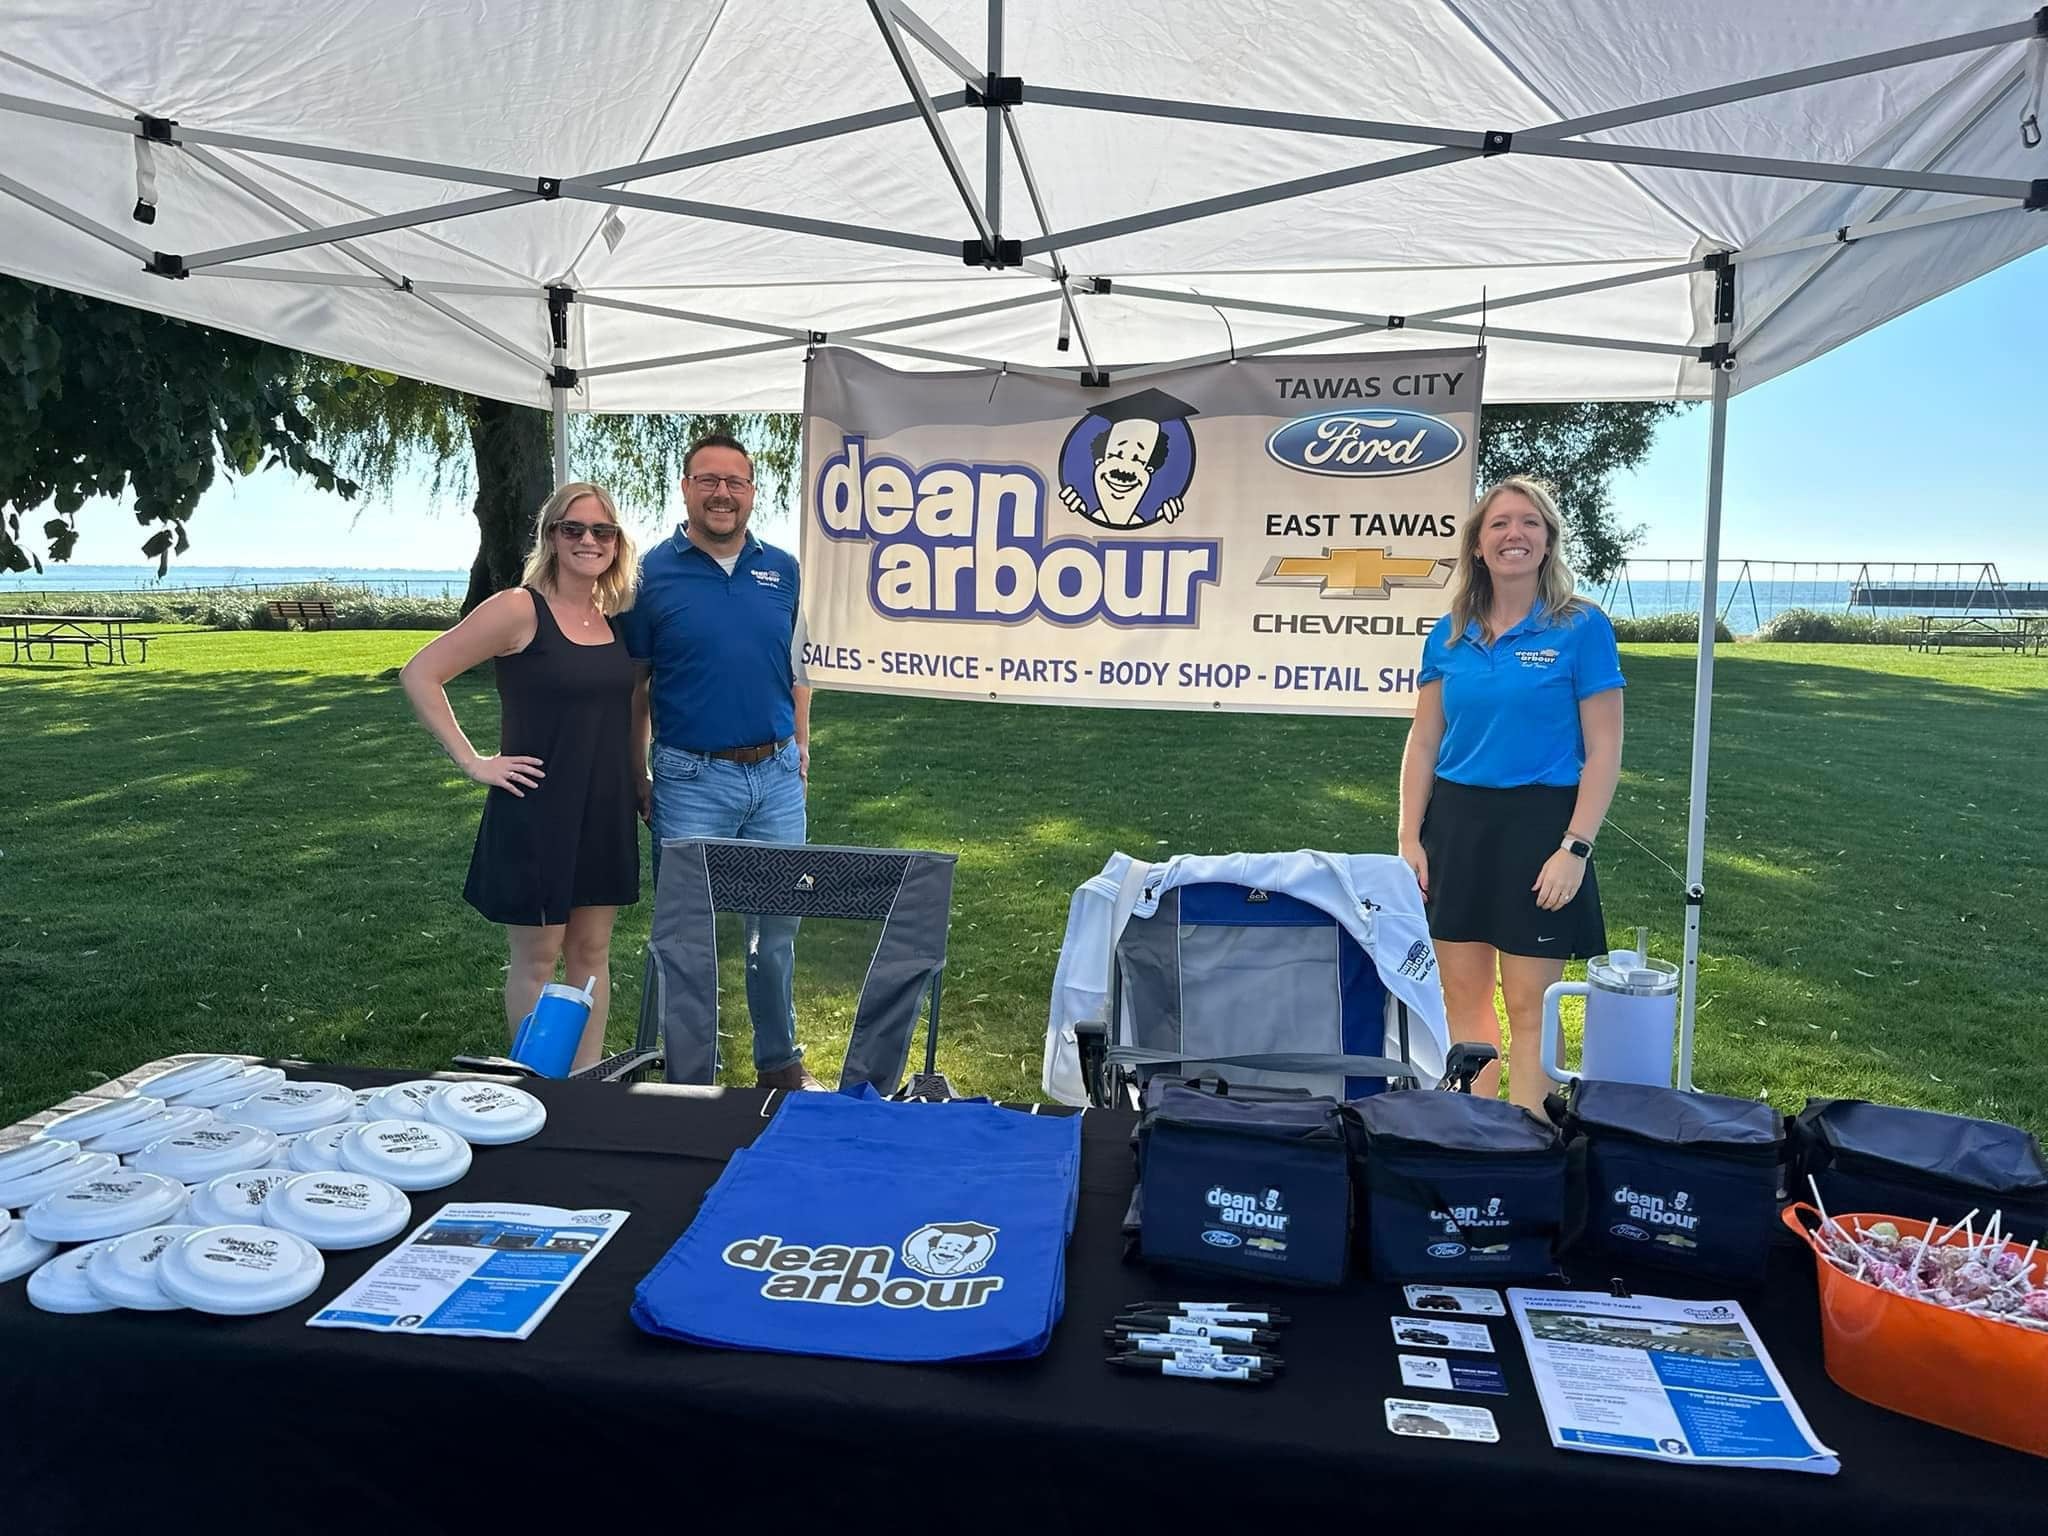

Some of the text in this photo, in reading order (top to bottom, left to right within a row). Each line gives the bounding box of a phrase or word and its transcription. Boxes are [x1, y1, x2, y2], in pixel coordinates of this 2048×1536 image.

[1275, 372, 1464, 399] TAWAS CITY
[1304, 416, 1428, 465] Ford
[820, 442, 1039, 538] dean
[1265, 513, 1456, 537] EAST TAWAS
[875, 541, 1211, 618] arbour
[1253, 614, 1441, 636] CHEVROLE
[801, 641, 862, 671] SALES
[881, 651, 979, 681] SERVICE
[1000, 658, 1077, 685] PARTS
[1100, 661, 1169, 688] BODY
[1178, 663, 1250, 690] SHOP
[1274, 665, 1368, 693] DETAIL
[1378, 667, 1415, 693] SH
[1520, 656, 1556, 664] arbour
[1207, 1187, 1256, 1210] dean
[1614, 1187, 1664, 1210] dean
[1222, 1207, 1288, 1230] arbour
[1630, 1205, 1698, 1229] arbour
[724, 1236, 891, 1274] dean
[1434, 1244, 1459, 1256] Ford
[763, 1274, 1000, 1308] arbour
